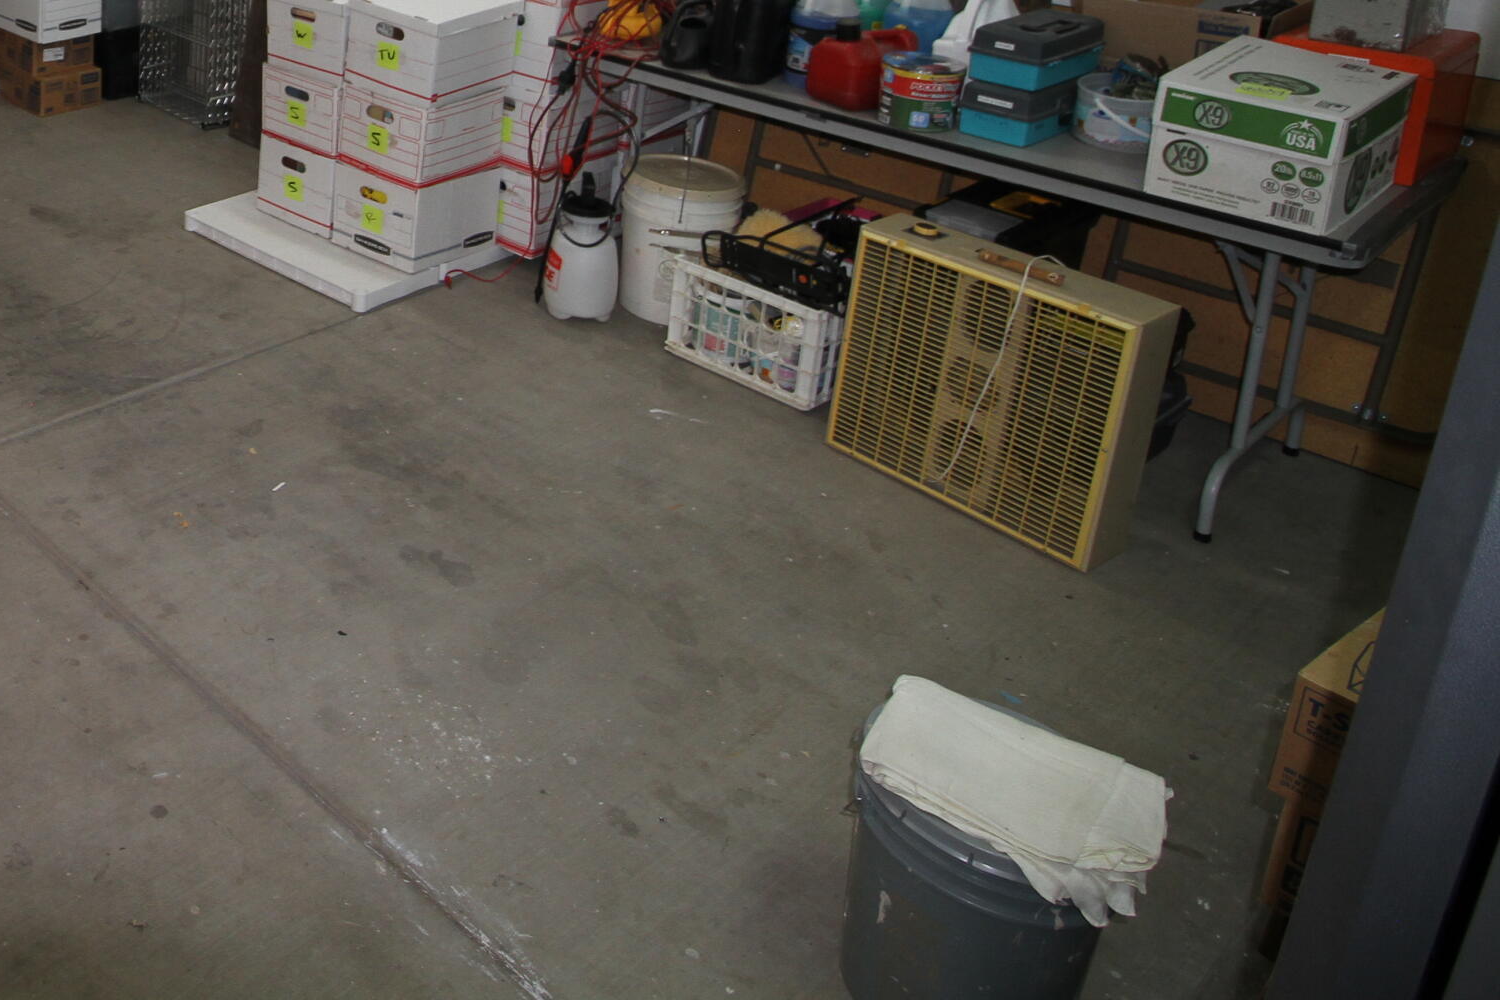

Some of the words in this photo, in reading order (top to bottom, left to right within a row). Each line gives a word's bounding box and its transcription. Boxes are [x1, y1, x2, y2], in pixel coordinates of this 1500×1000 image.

[1285, 131, 1317, 151] USA
[1170, 143, 1200, 171] X-9
[287, 180, 298, 193] S
